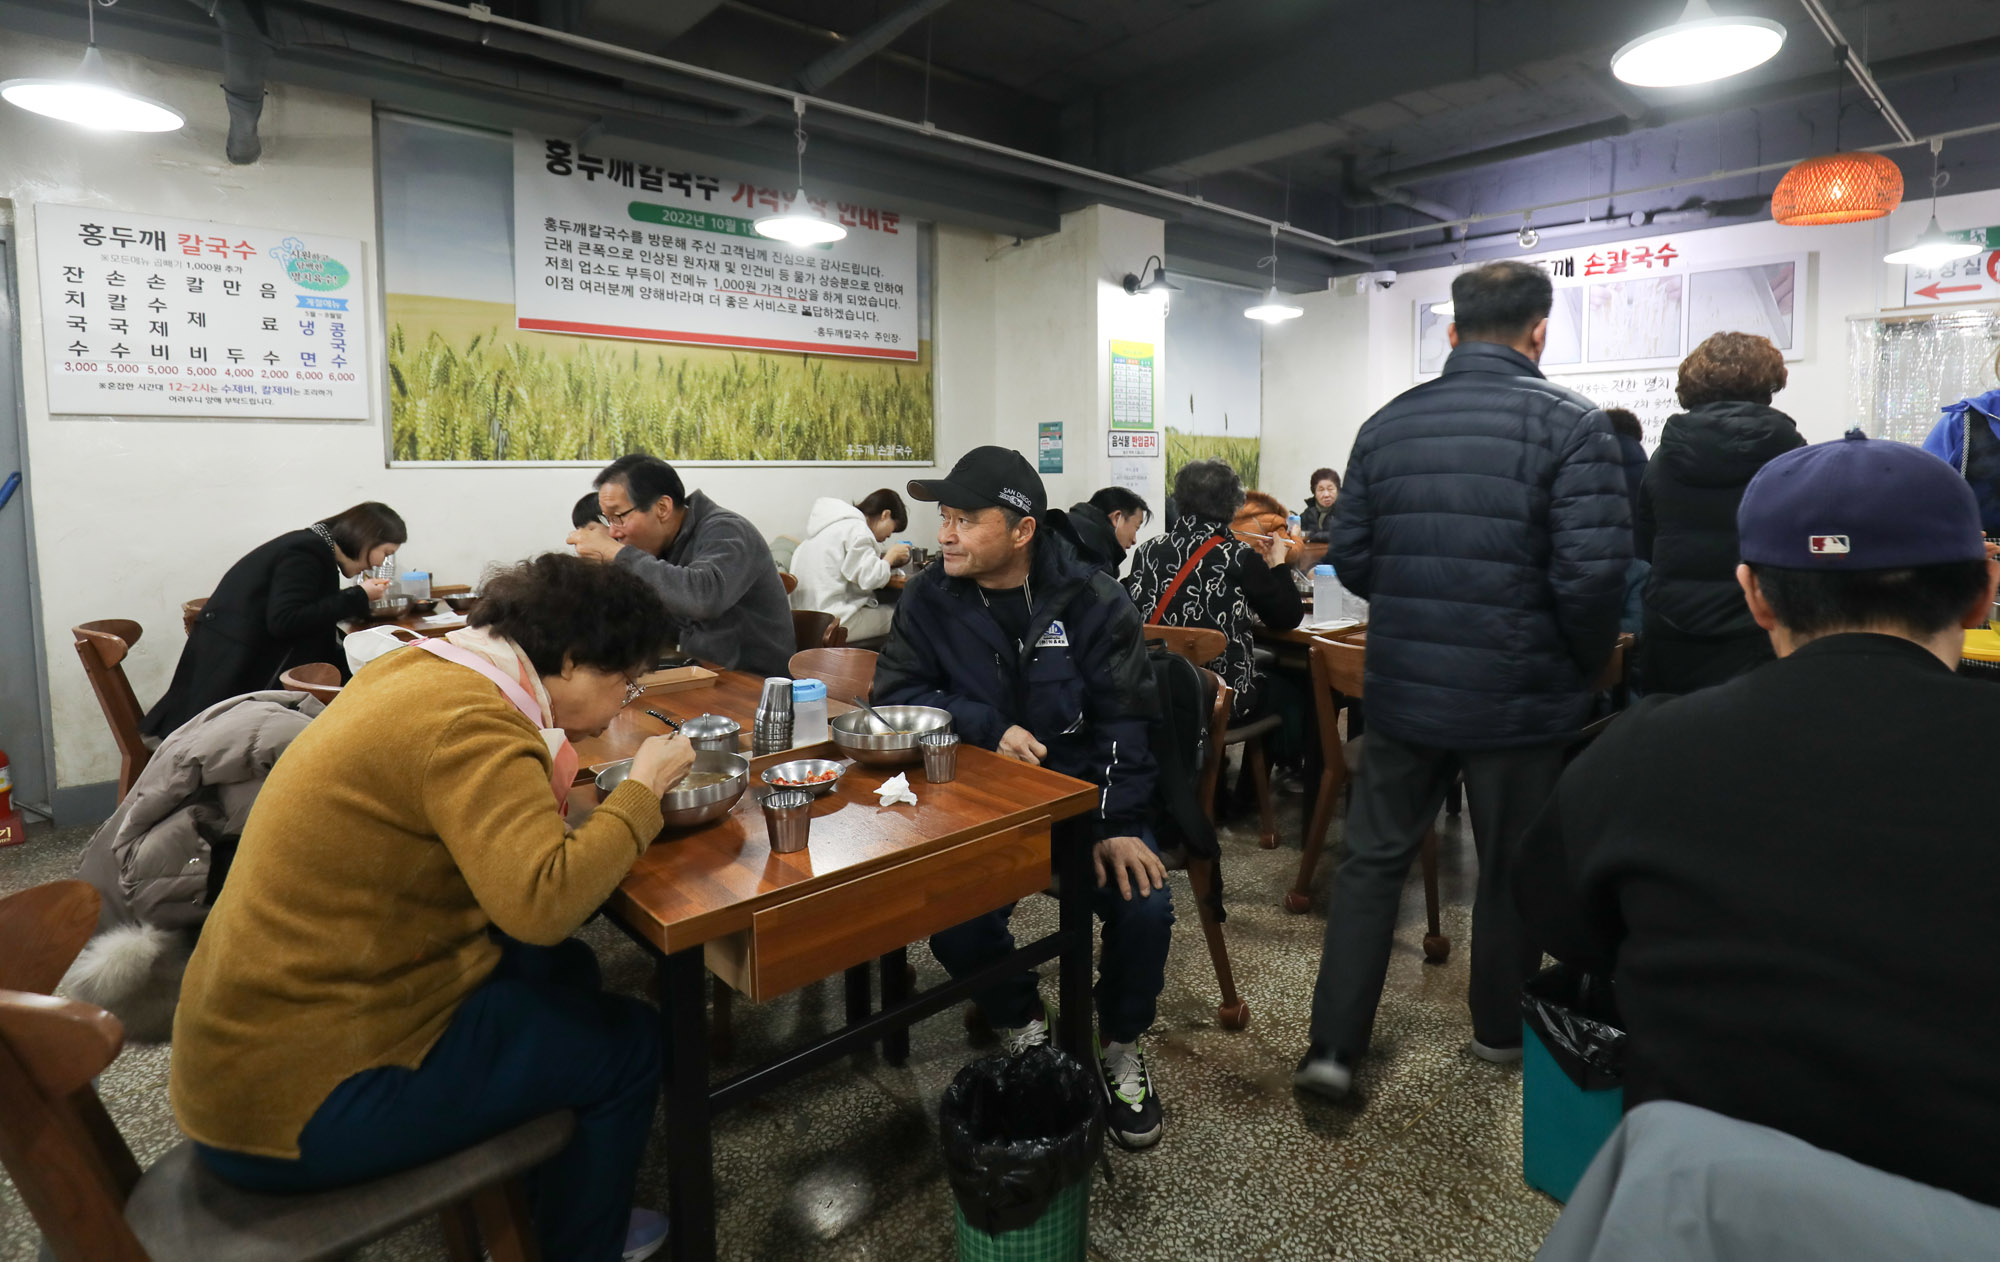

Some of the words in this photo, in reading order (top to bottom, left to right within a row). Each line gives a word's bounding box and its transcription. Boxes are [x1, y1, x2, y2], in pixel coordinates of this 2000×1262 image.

[662, 209, 705, 229] 2022년
[711, 217, 737, 233] 10월
[78, 223, 166, 252] 홍두깨
[177, 232, 257, 260] 칼국수
[544, 216, 644, 245] 홍두깨칼국수를
[648, 233, 687, 250] 방문해
[691, 239, 716, 255] 주신
[720, 243, 768, 262] 고객님께
[771, 251, 817, 268] 진심으로
[820, 258, 885, 278] 감사드립니다.
[186, 261, 222, 273] 1,000원
[225, 264, 243, 275] 추가
[544, 236, 572, 253] 근래
[577, 241, 635, 261] 큰폭으로
[639, 250, 678, 267] 인상된
[683, 255, 720, 273] 원자재
[724, 261, 736, 275] 및
[740, 264, 775, 280] 인건비
[779, 270, 790, 282] 등
[793, 271, 816, 284] 물가
[819, 275, 871, 292] 상승분으로
[873, 281, 904, 295] 인하여
[1584, 242, 1679, 276] 손칼국수
[545, 256, 573, 272] 저희
[578, 260, 620, 277] 업소도
[625, 266, 665, 284] 부득이
[670, 273, 708, 288] 전메뉴
[714, 278, 757, 294] 1,000원
[761, 283, 783, 297] 가격
[786, 286, 819, 302] 인상을
[823, 291, 843, 305] 하게
[846, 294, 901, 310] 되었습니다.
[545, 275, 574, 291] 이점
[580, 279, 634, 298] 여러분께
[639, 287, 704, 305] 양해바라며
[709, 295, 721, 307] 더
[726, 296, 750, 310] 좋은
[753, 298, 798, 314] 서비스로
[64, 361, 98, 372] 3,000
[106, 363, 139, 374] 5,000
[147, 365, 179, 375] 5,000
[186, 366, 217, 377] 5,000
[224, 368, 254, 378] 4,000
[261, 369, 289, 379] 2,000
[296, 371, 323, 381] 6,000
[329, 372, 355, 382] 6,000
[138, 383, 164, 392] 시간대
[221, 384, 257, 395] 수제비,
[261, 385, 301, 396] 칼제비는
[303, 388, 333, 397] 조리하기
[1612, 379, 1637, 393] 진한
[1644, 376, 1670, 393] 멸치
[168, 395, 203, 404] 어려우니
[205, 395, 222, 405] 양해
[846, 443, 875, 457] 홍두깨
[877, 444, 912, 457] 손칼국수
[1112, 435, 1130, 448] 음식물
[1132, 436, 1155, 448] 반입금지
[1003, 487, 1016, 496] SAN
[1016, 492, 1032, 506] DIEGO
